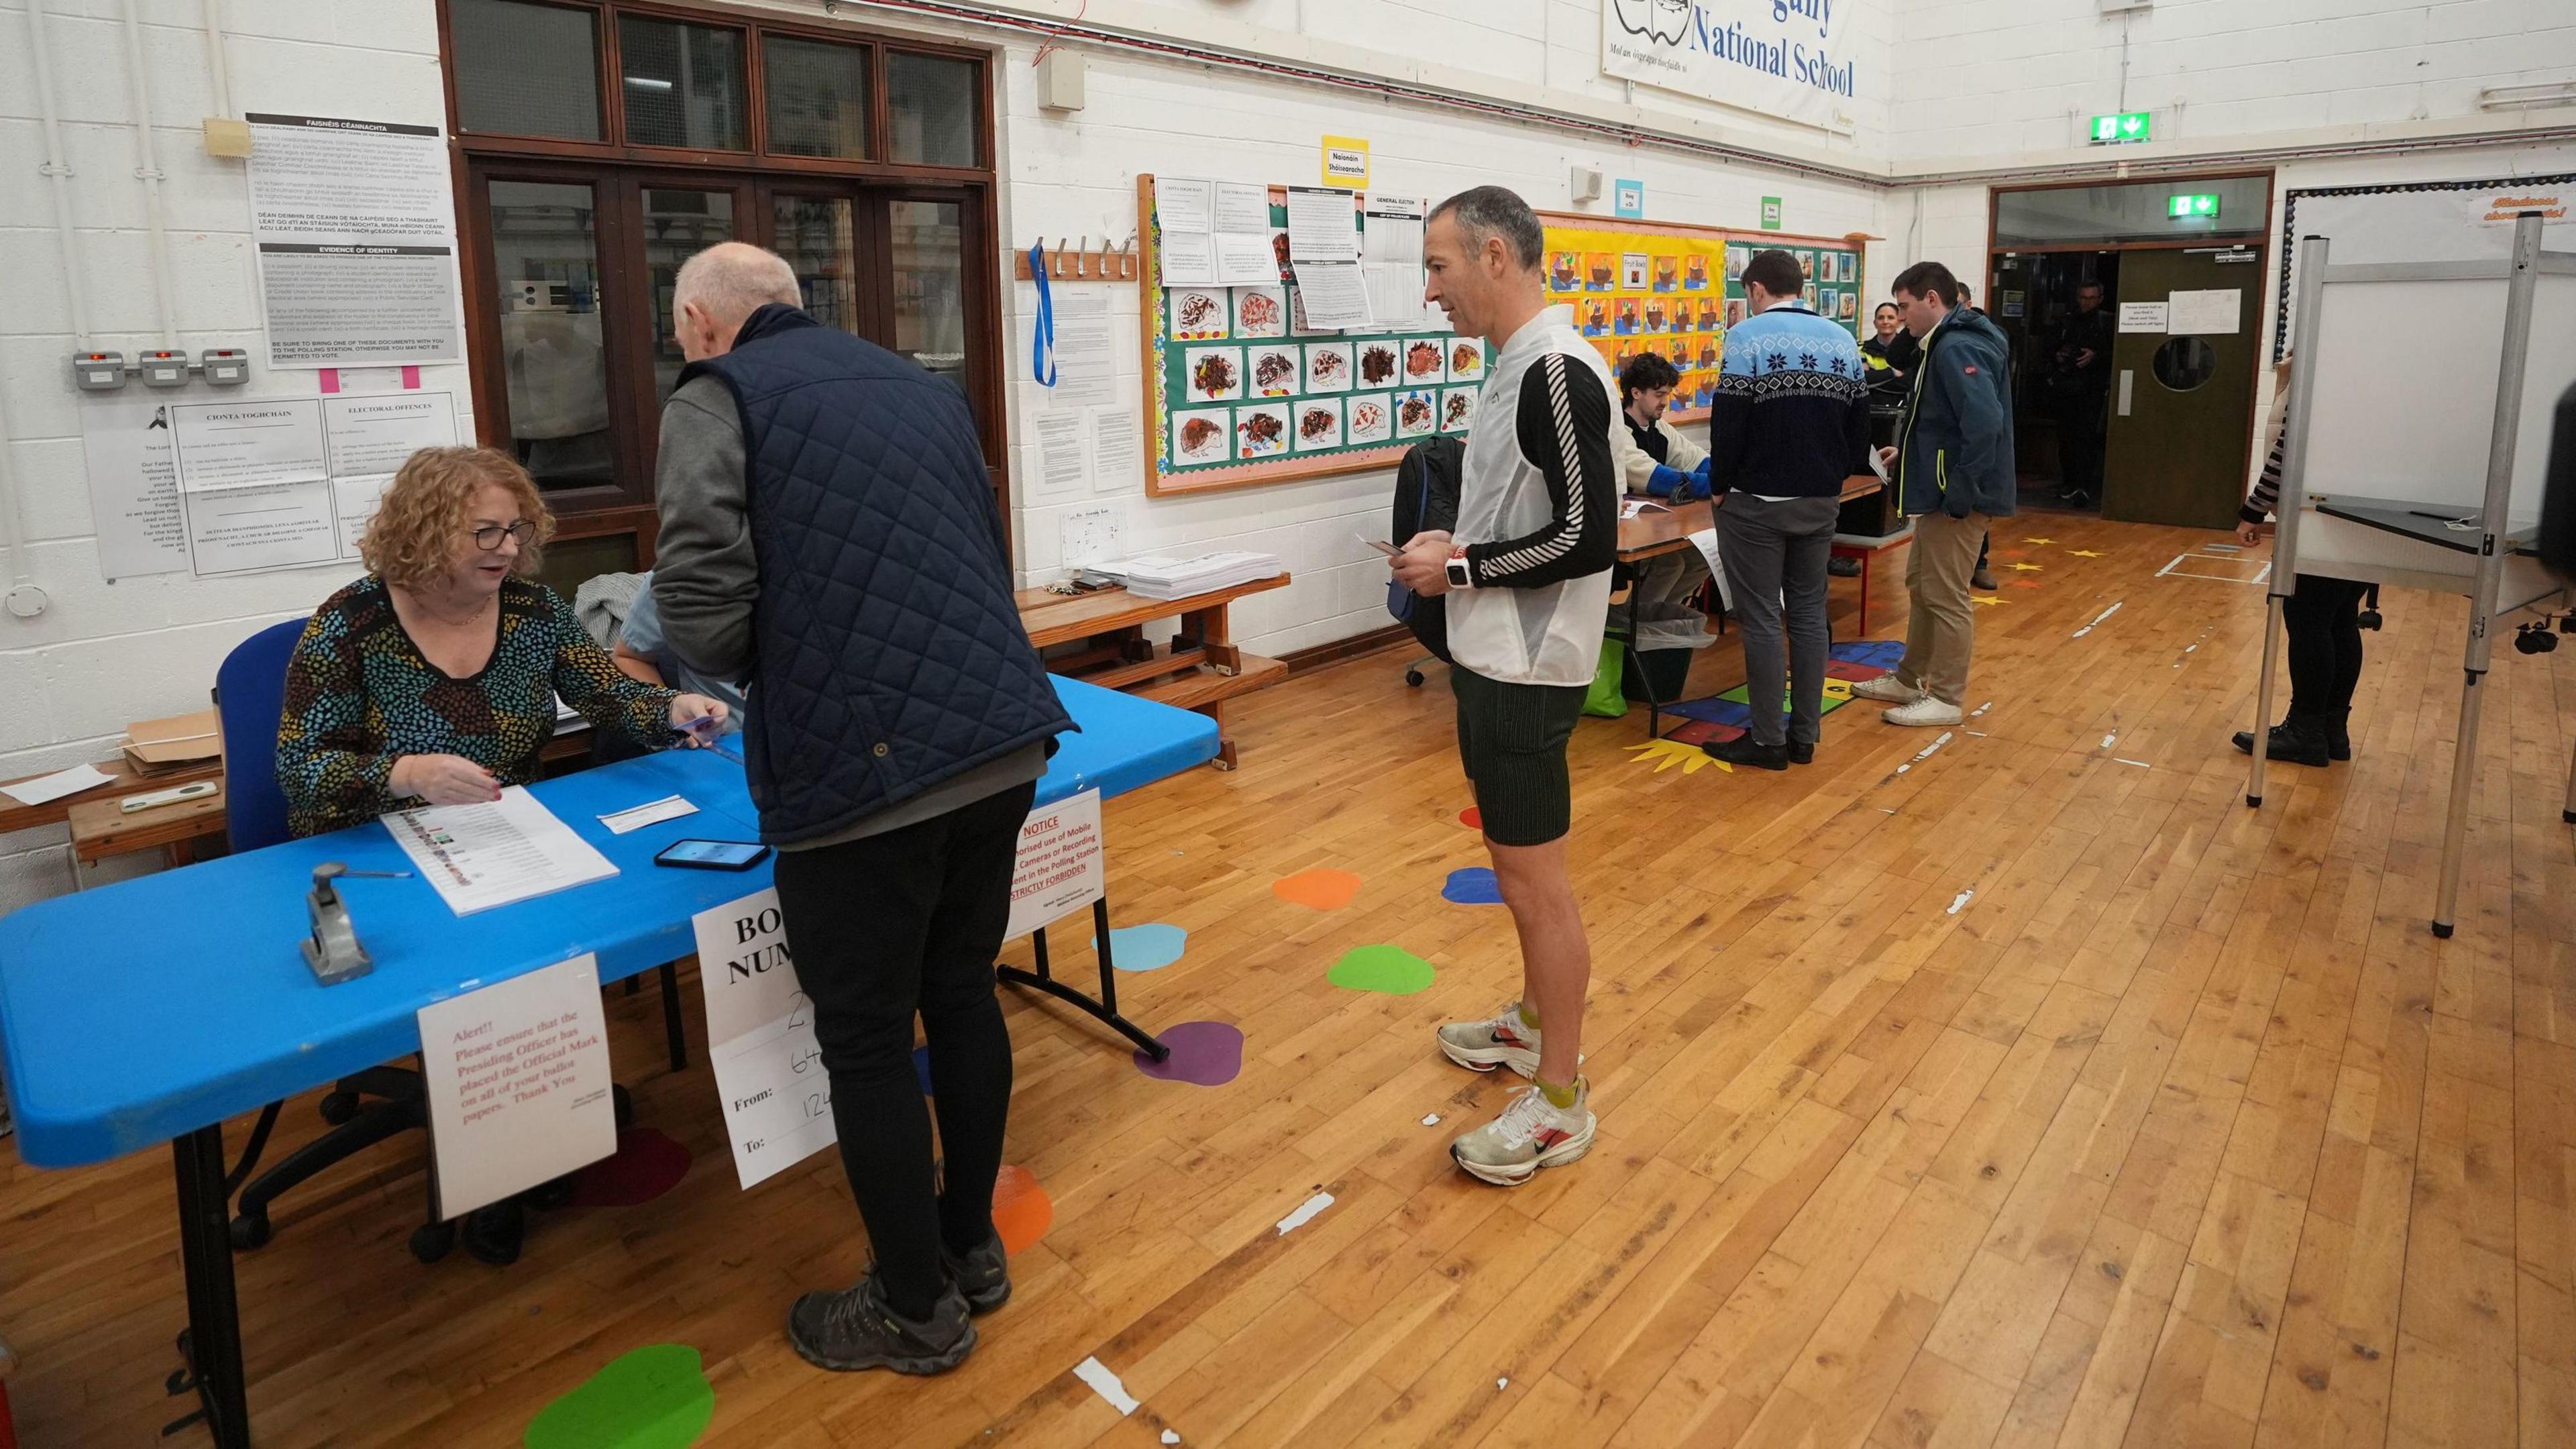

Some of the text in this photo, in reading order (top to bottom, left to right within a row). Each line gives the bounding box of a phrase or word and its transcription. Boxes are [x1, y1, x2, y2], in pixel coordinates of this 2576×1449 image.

[1610, 43, 1622, 54] Mol
[1690, 5, 1853, 98] National School
[307, 119, 387, 132] FAISNÉIS CÉANNACHTA
[207, 413, 239, 421] CIONTA
[348, 403, 432, 414] ELECTORAL OFFENCES
[1023, 815, 1059, 837] NOTICE
[1044, 837, 1056, 847] use
[1058, 830, 1066, 841] of
[1067, 822, 1091, 838] Mobile
[1019, 834, 1096, 869] Cameras or Recording
[1028, 871, 1036, 879] in
[1038, 866, 1049, 876] the
[1051, 856, 1075, 871] Polling
[1076, 845, 1099, 861] Station
[1010, 879, 1044, 900] STRICTLY
[1046, 863, 1087, 885] FORBIDDEN
[453, 1020, 493, 1044] Alert!!
[455, 1012, 578, 1063] Please ensure that the
[458, 1028, 579, 1078] Presiding Officer has
[460, 1034, 599, 1097] placed the Official Mark
[461, 1060, 575, 1108] on all of your ballot
[463, 1104, 504, 1126] papers.
[512, 1083, 549, 1104] Thank
[553, 1075, 576, 1089] You
[733, 1087, 774, 1114] From:
[743, 1136, 765, 1155] To:
